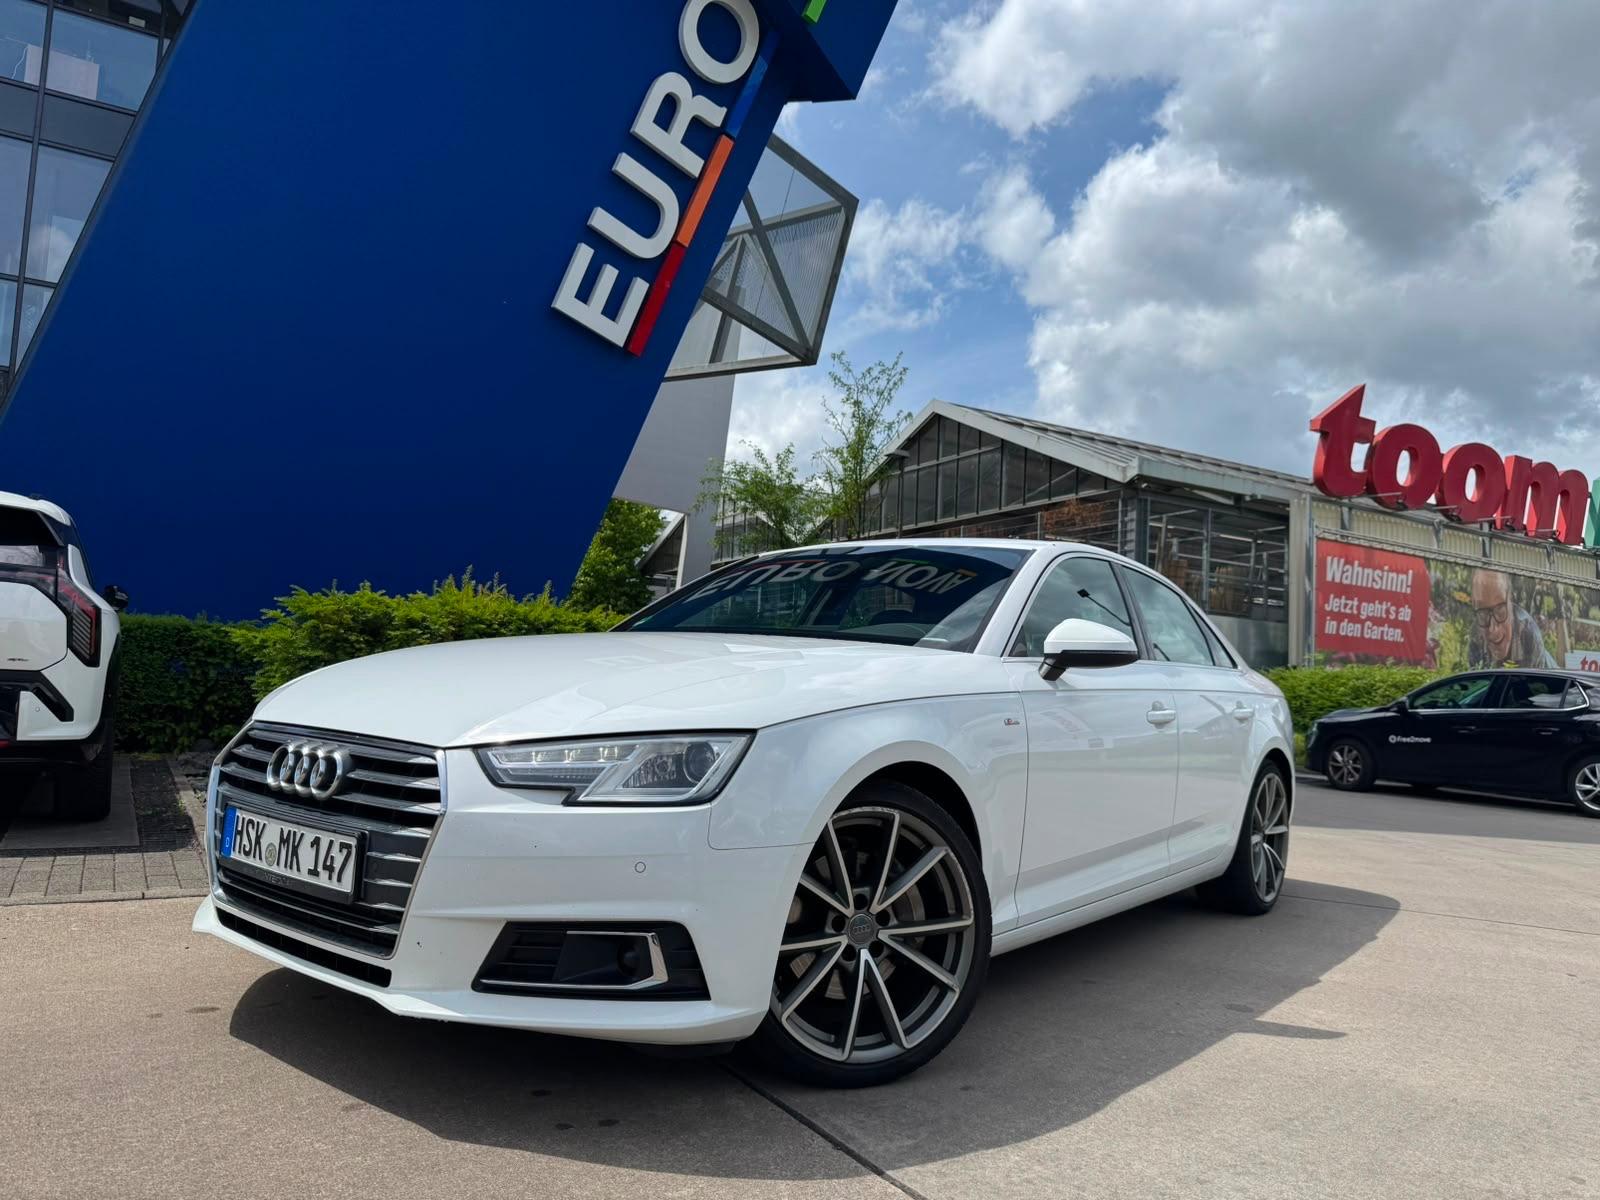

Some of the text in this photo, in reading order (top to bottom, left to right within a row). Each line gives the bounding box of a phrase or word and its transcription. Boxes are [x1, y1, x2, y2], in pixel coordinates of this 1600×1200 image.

[551, 0, 759, 348] EURO
[1310, 383, 1589, 545] toom
[1325, 555, 1413, 594] Wahnsinn!
[1324, 594, 1411, 622] Jetzt geht's ab
[1325, 617, 1404, 643] in den Garten.
[1580, 655, 1600, 672] to
[233, 814, 267, 861] HSK
[276, 827, 304, 873] MK
[308, 835, 353, 883] 147
